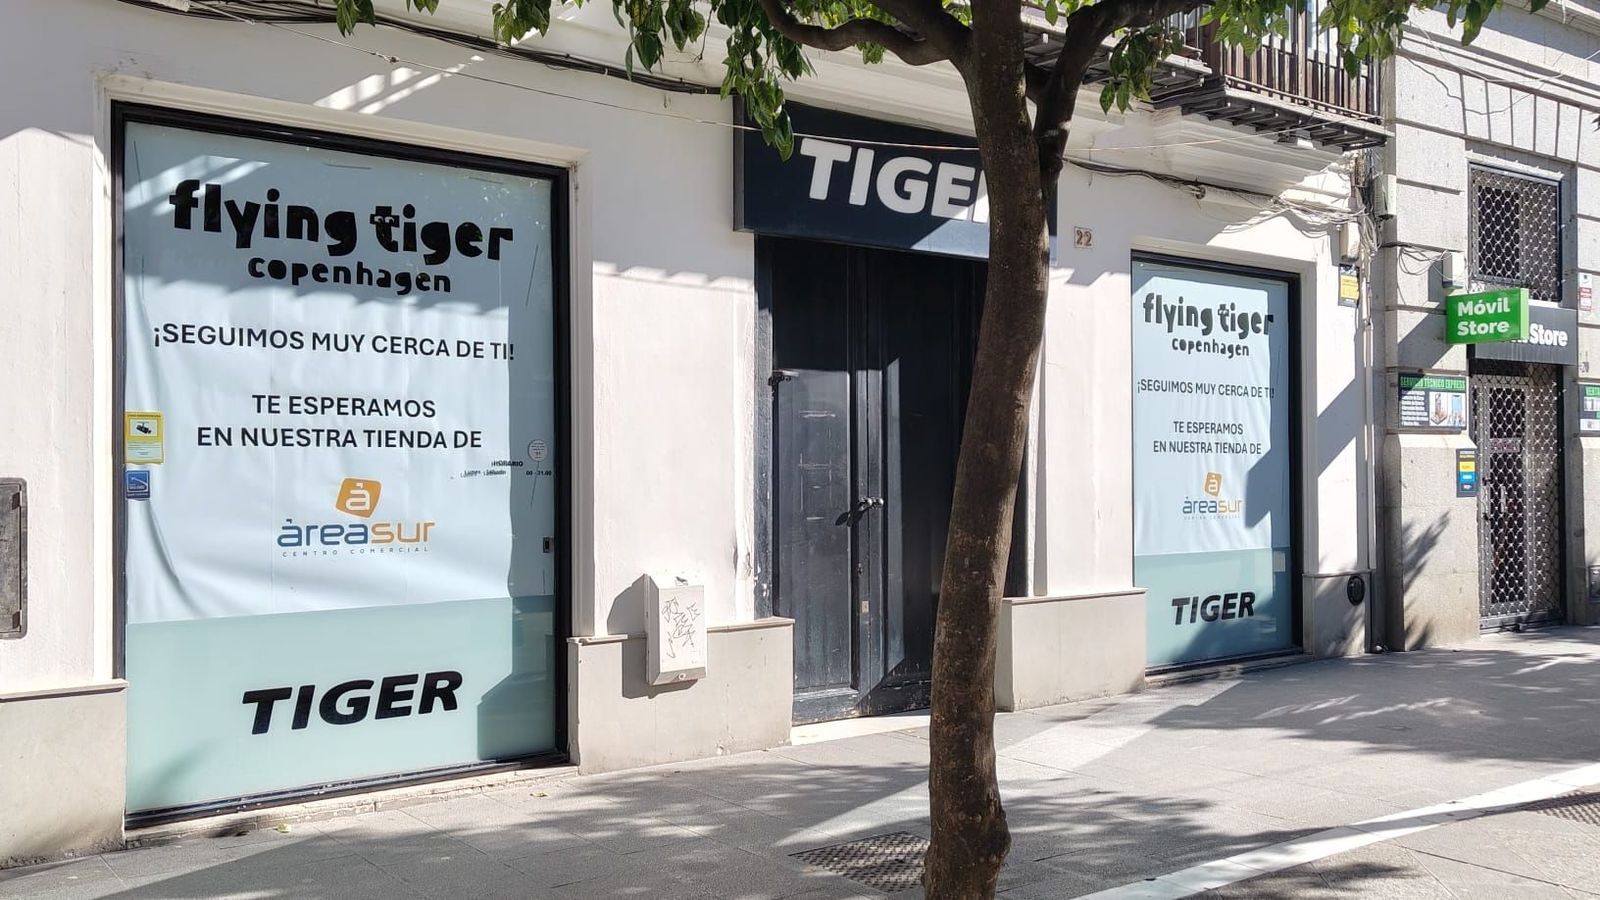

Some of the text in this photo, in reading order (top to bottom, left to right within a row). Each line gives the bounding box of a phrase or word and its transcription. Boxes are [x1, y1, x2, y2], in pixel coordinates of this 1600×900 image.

[169, 179, 514, 265] flying tiger
[1076, 230, 1092, 247] 22
[248, 257, 451, 295] copenhagen
[1143, 292, 1274, 339] flying tiger
[1457, 297, 1511, 317] Móvil
[1457, 321, 1510, 336] Store
[1529, 323, 1568, 347] Store
[153, 323, 514, 361] ¡SEGUIMOS MUY CERCA DE TI!
[1171, 337, 1250, 359] copenhagen
[1137, 378, 1275, 399] ¡SEGUIMOS MUY CERCA DE TI!
[252, 395, 436, 418] TE ESPERAMOS
[197, 427, 482, 448] EN NUESTRA TIENDA DE
[1173, 420, 1244, 435] TE ESPERAMOS
[1153, 441, 1262, 455] EN NUESTRA TIENDA DE
[282, 546, 429, 558] CENTRO COMERCIAL
[1171, 591, 1256, 625] TIGER
[242, 669, 464, 735] TIGER
